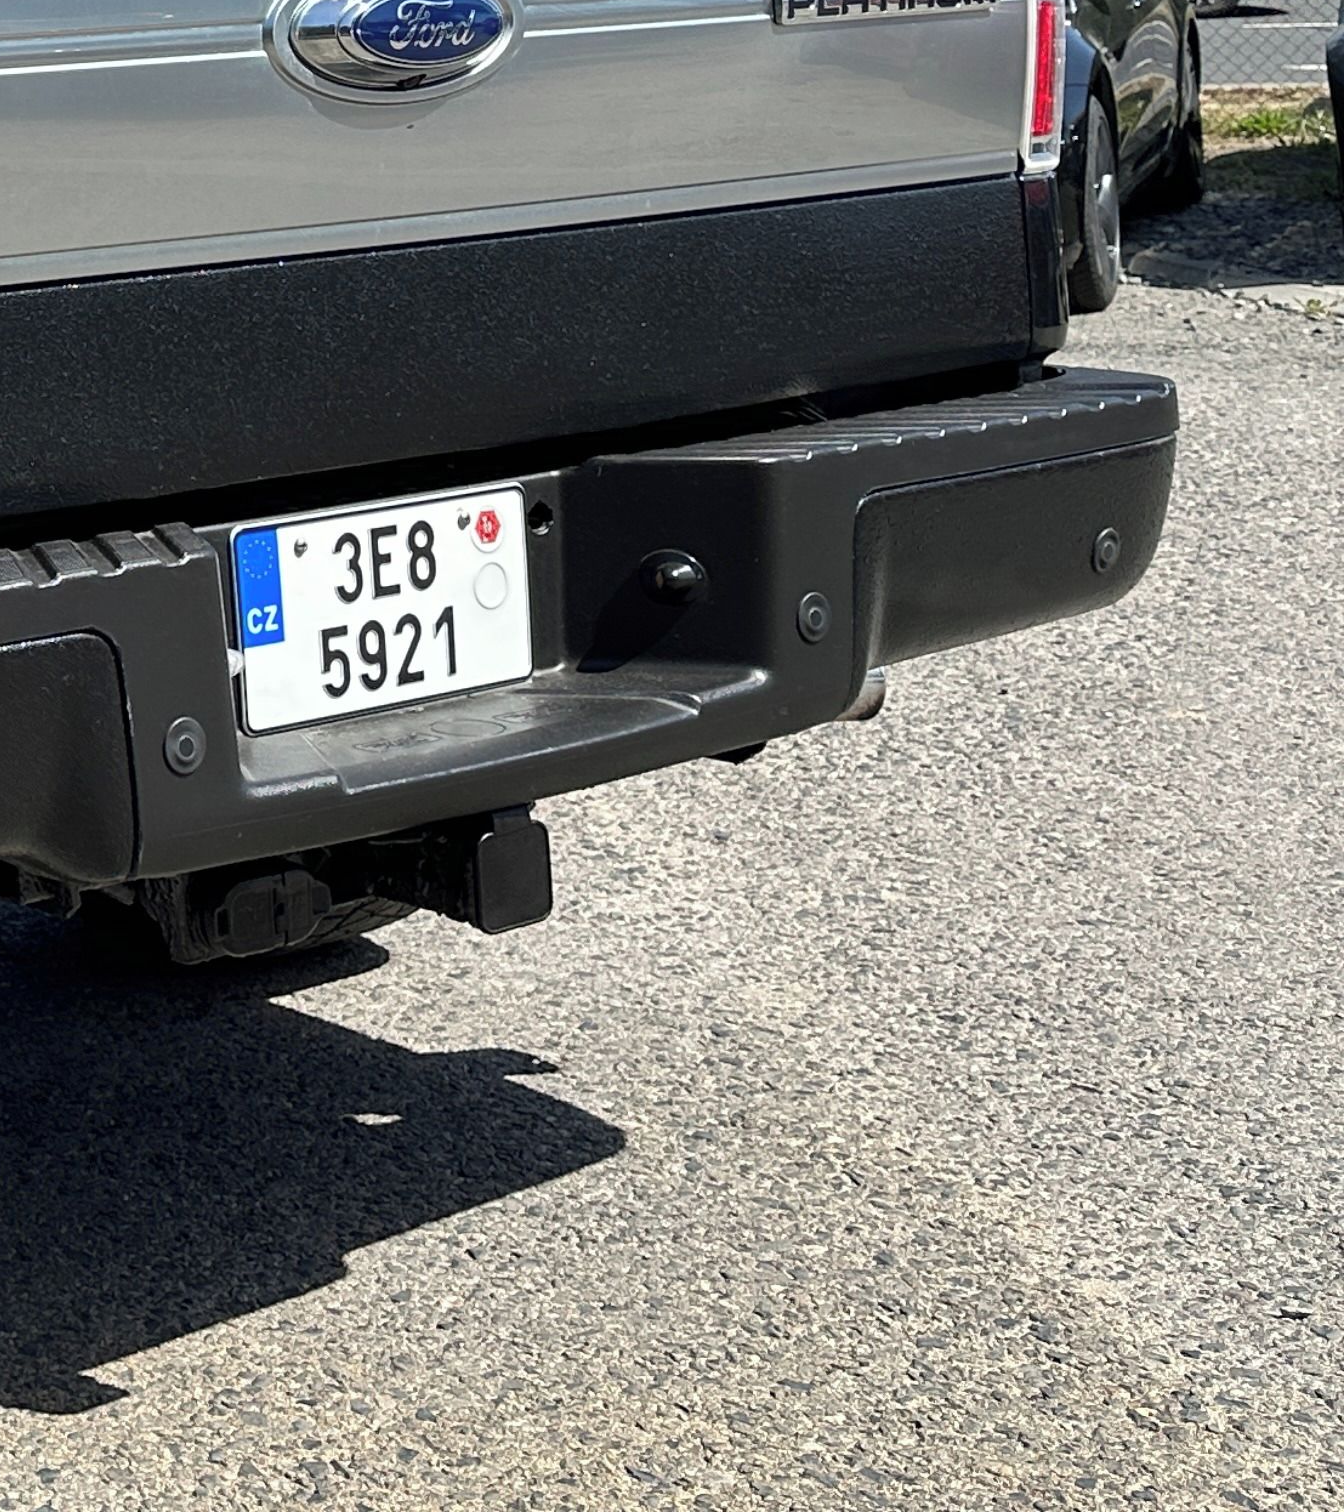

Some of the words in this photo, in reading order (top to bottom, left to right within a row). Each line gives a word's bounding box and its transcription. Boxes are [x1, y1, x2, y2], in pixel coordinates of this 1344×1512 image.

[389, 0, 476, 50] Ford
[332, 520, 437, 604] 3E8
[247, 604, 279, 635] CZ
[319, 605, 458, 699] 5921
